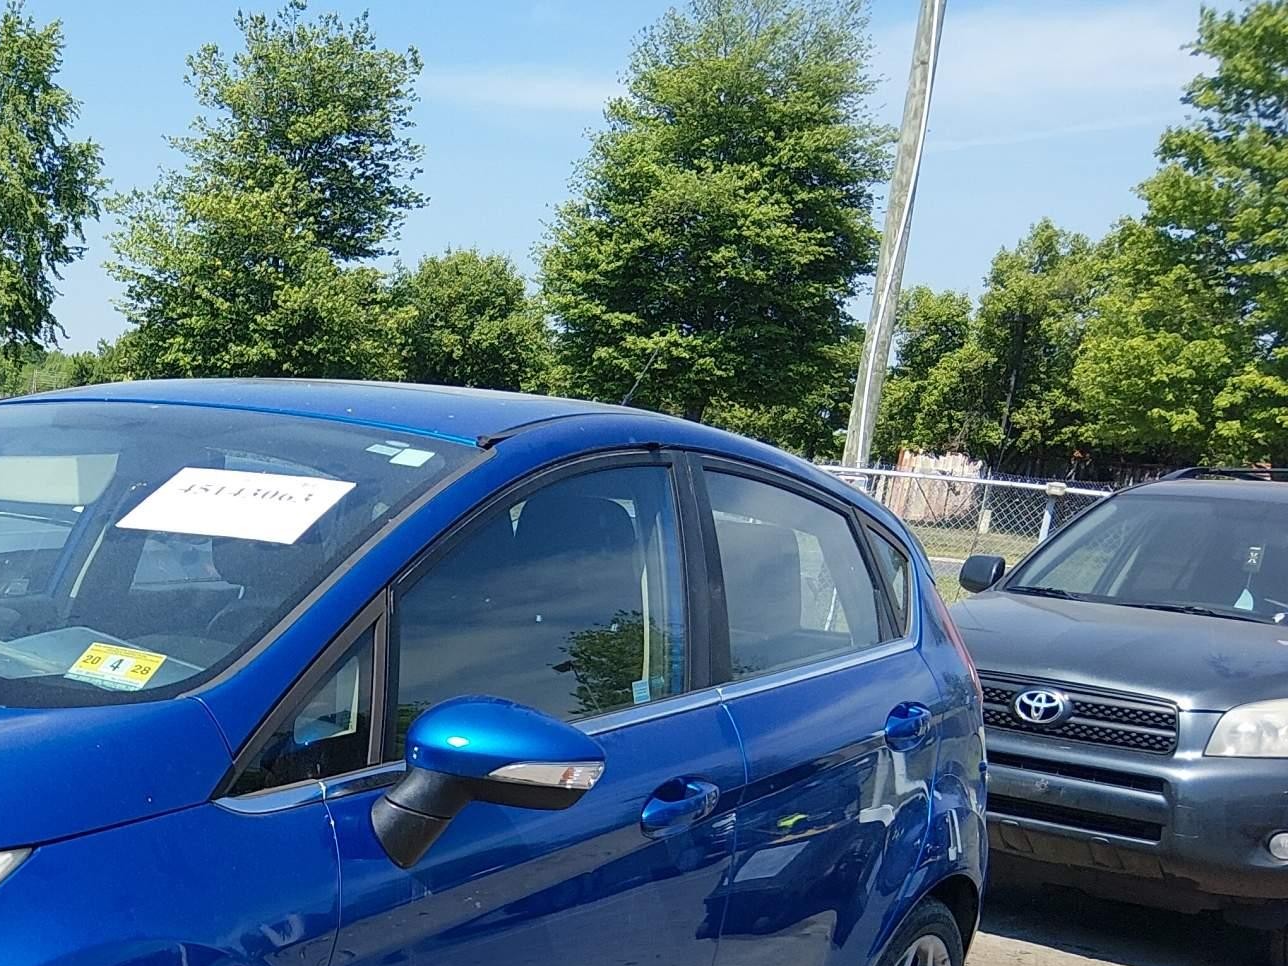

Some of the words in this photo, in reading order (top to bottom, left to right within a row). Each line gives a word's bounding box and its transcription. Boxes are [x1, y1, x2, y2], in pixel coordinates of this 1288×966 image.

[82, 654, 101, 665] 20
[110, 658, 124, 671] 4
[130, 664, 151, 675] 28
